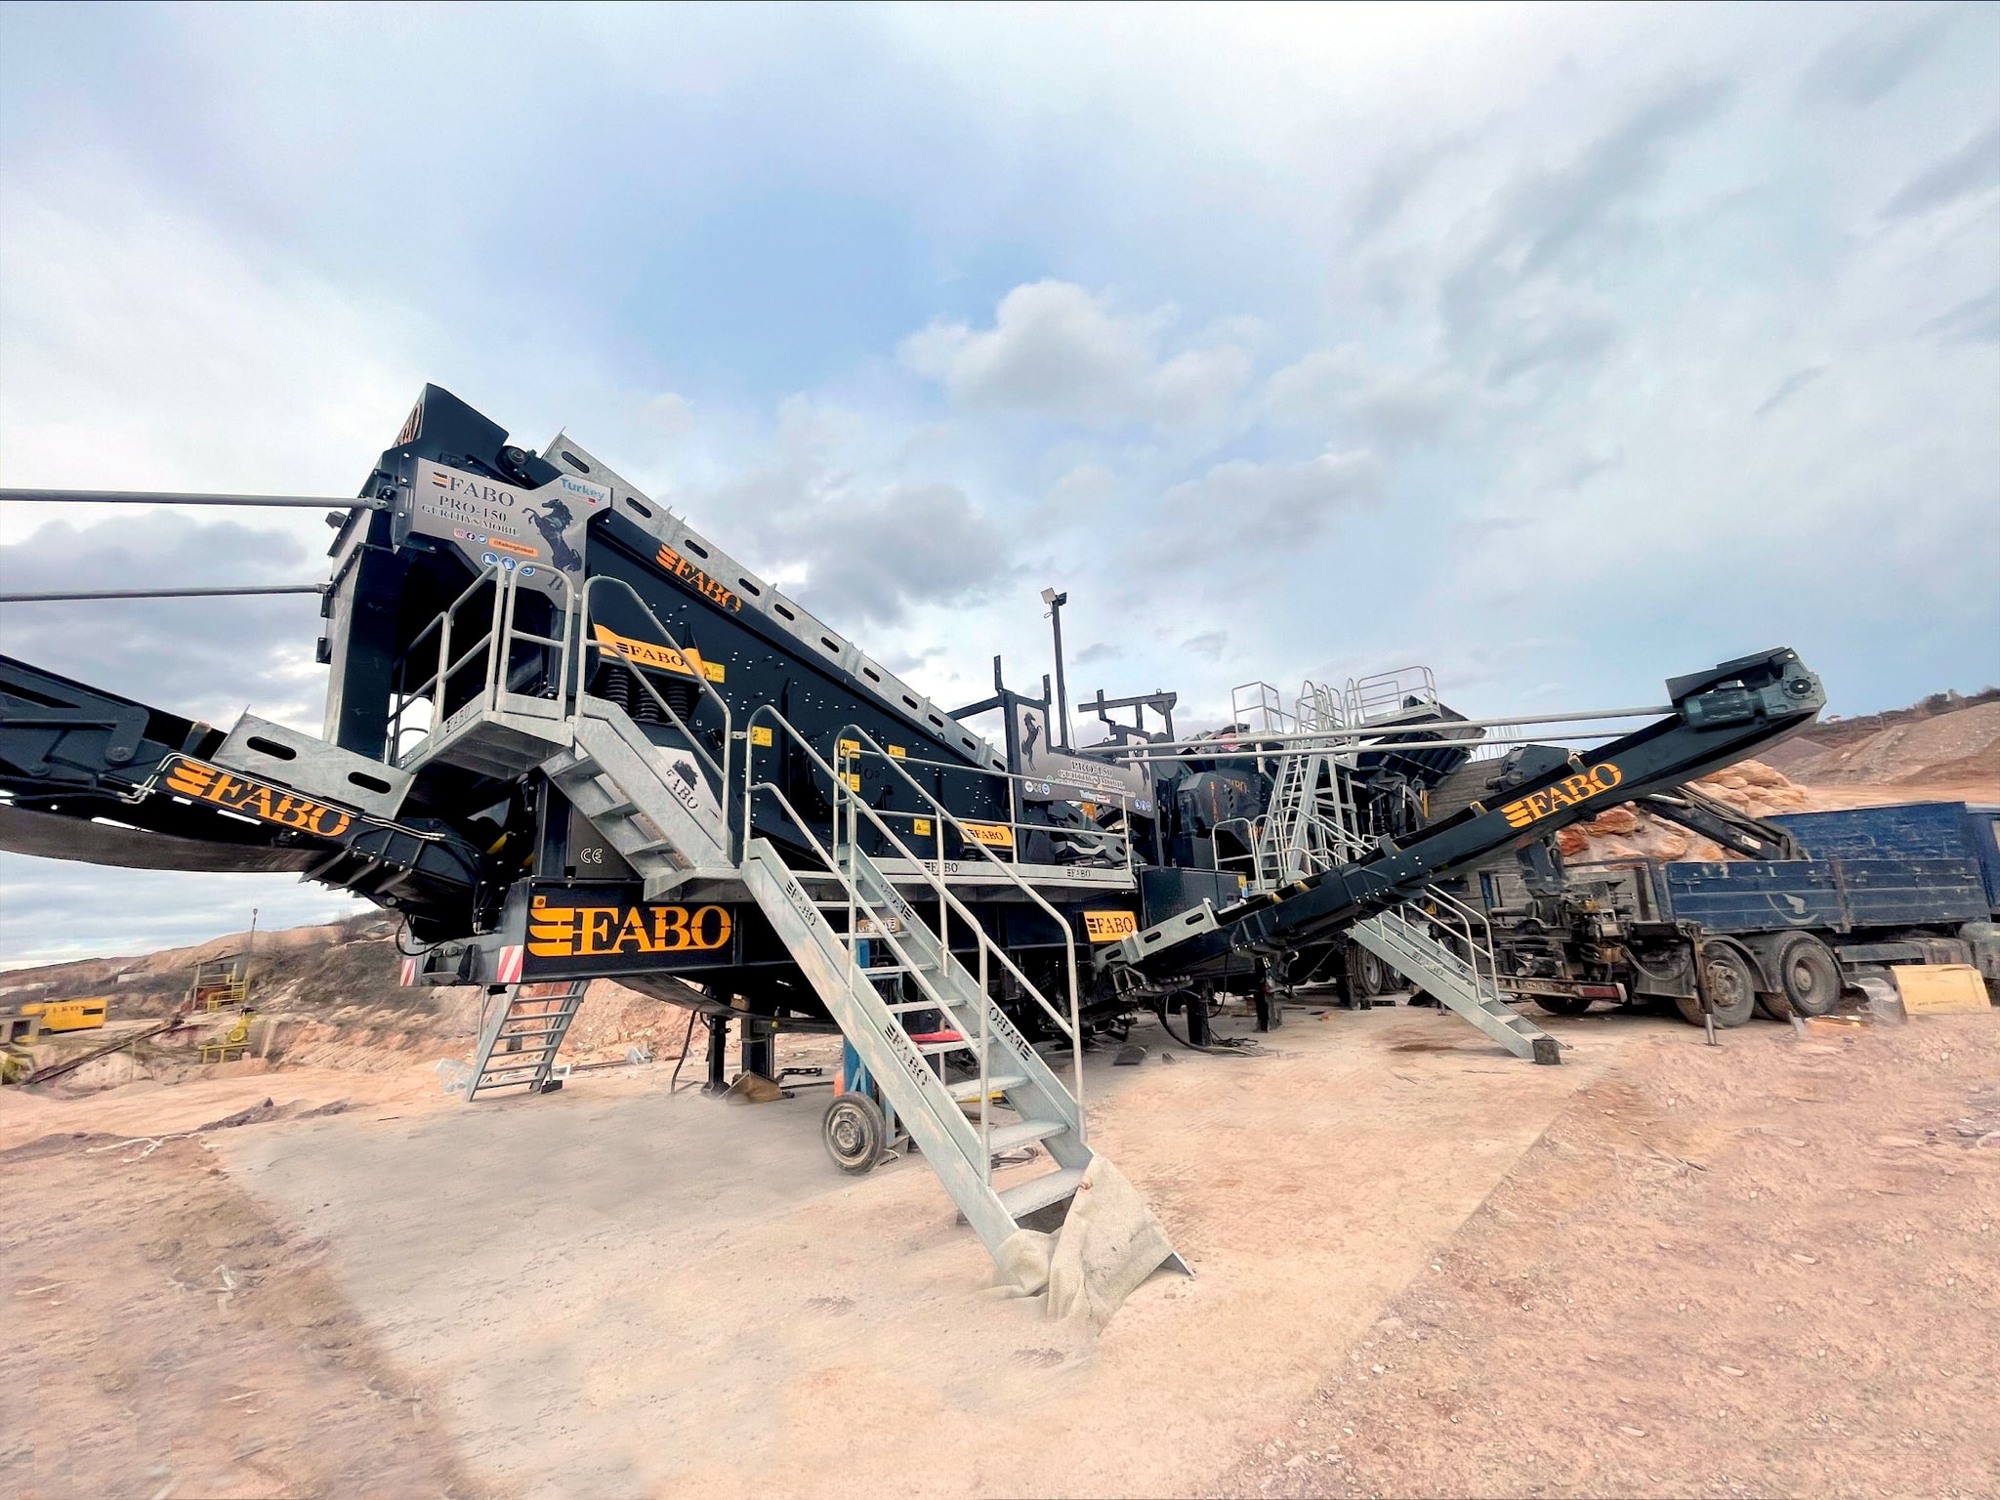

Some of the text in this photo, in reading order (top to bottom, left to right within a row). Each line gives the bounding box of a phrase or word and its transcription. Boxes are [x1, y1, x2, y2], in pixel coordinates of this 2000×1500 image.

[449, 476, 515, 507] FABO
[561, 477, 605, 502] Turkey
[440, 495, 507, 522] PRO-150
[673, 558, 742, 613] FABO
[630, 645, 685, 667] FABO
[1525, 763, 1622, 820] FABO
[201, 775, 351, 838] FABO
[974, 829, 1004, 841] FABO
[580, 847, 603, 864] CE
[931, 862, 959, 873] FBO
[573, 905, 732, 955] FABO
[1096, 917, 1133, 934] FABO
